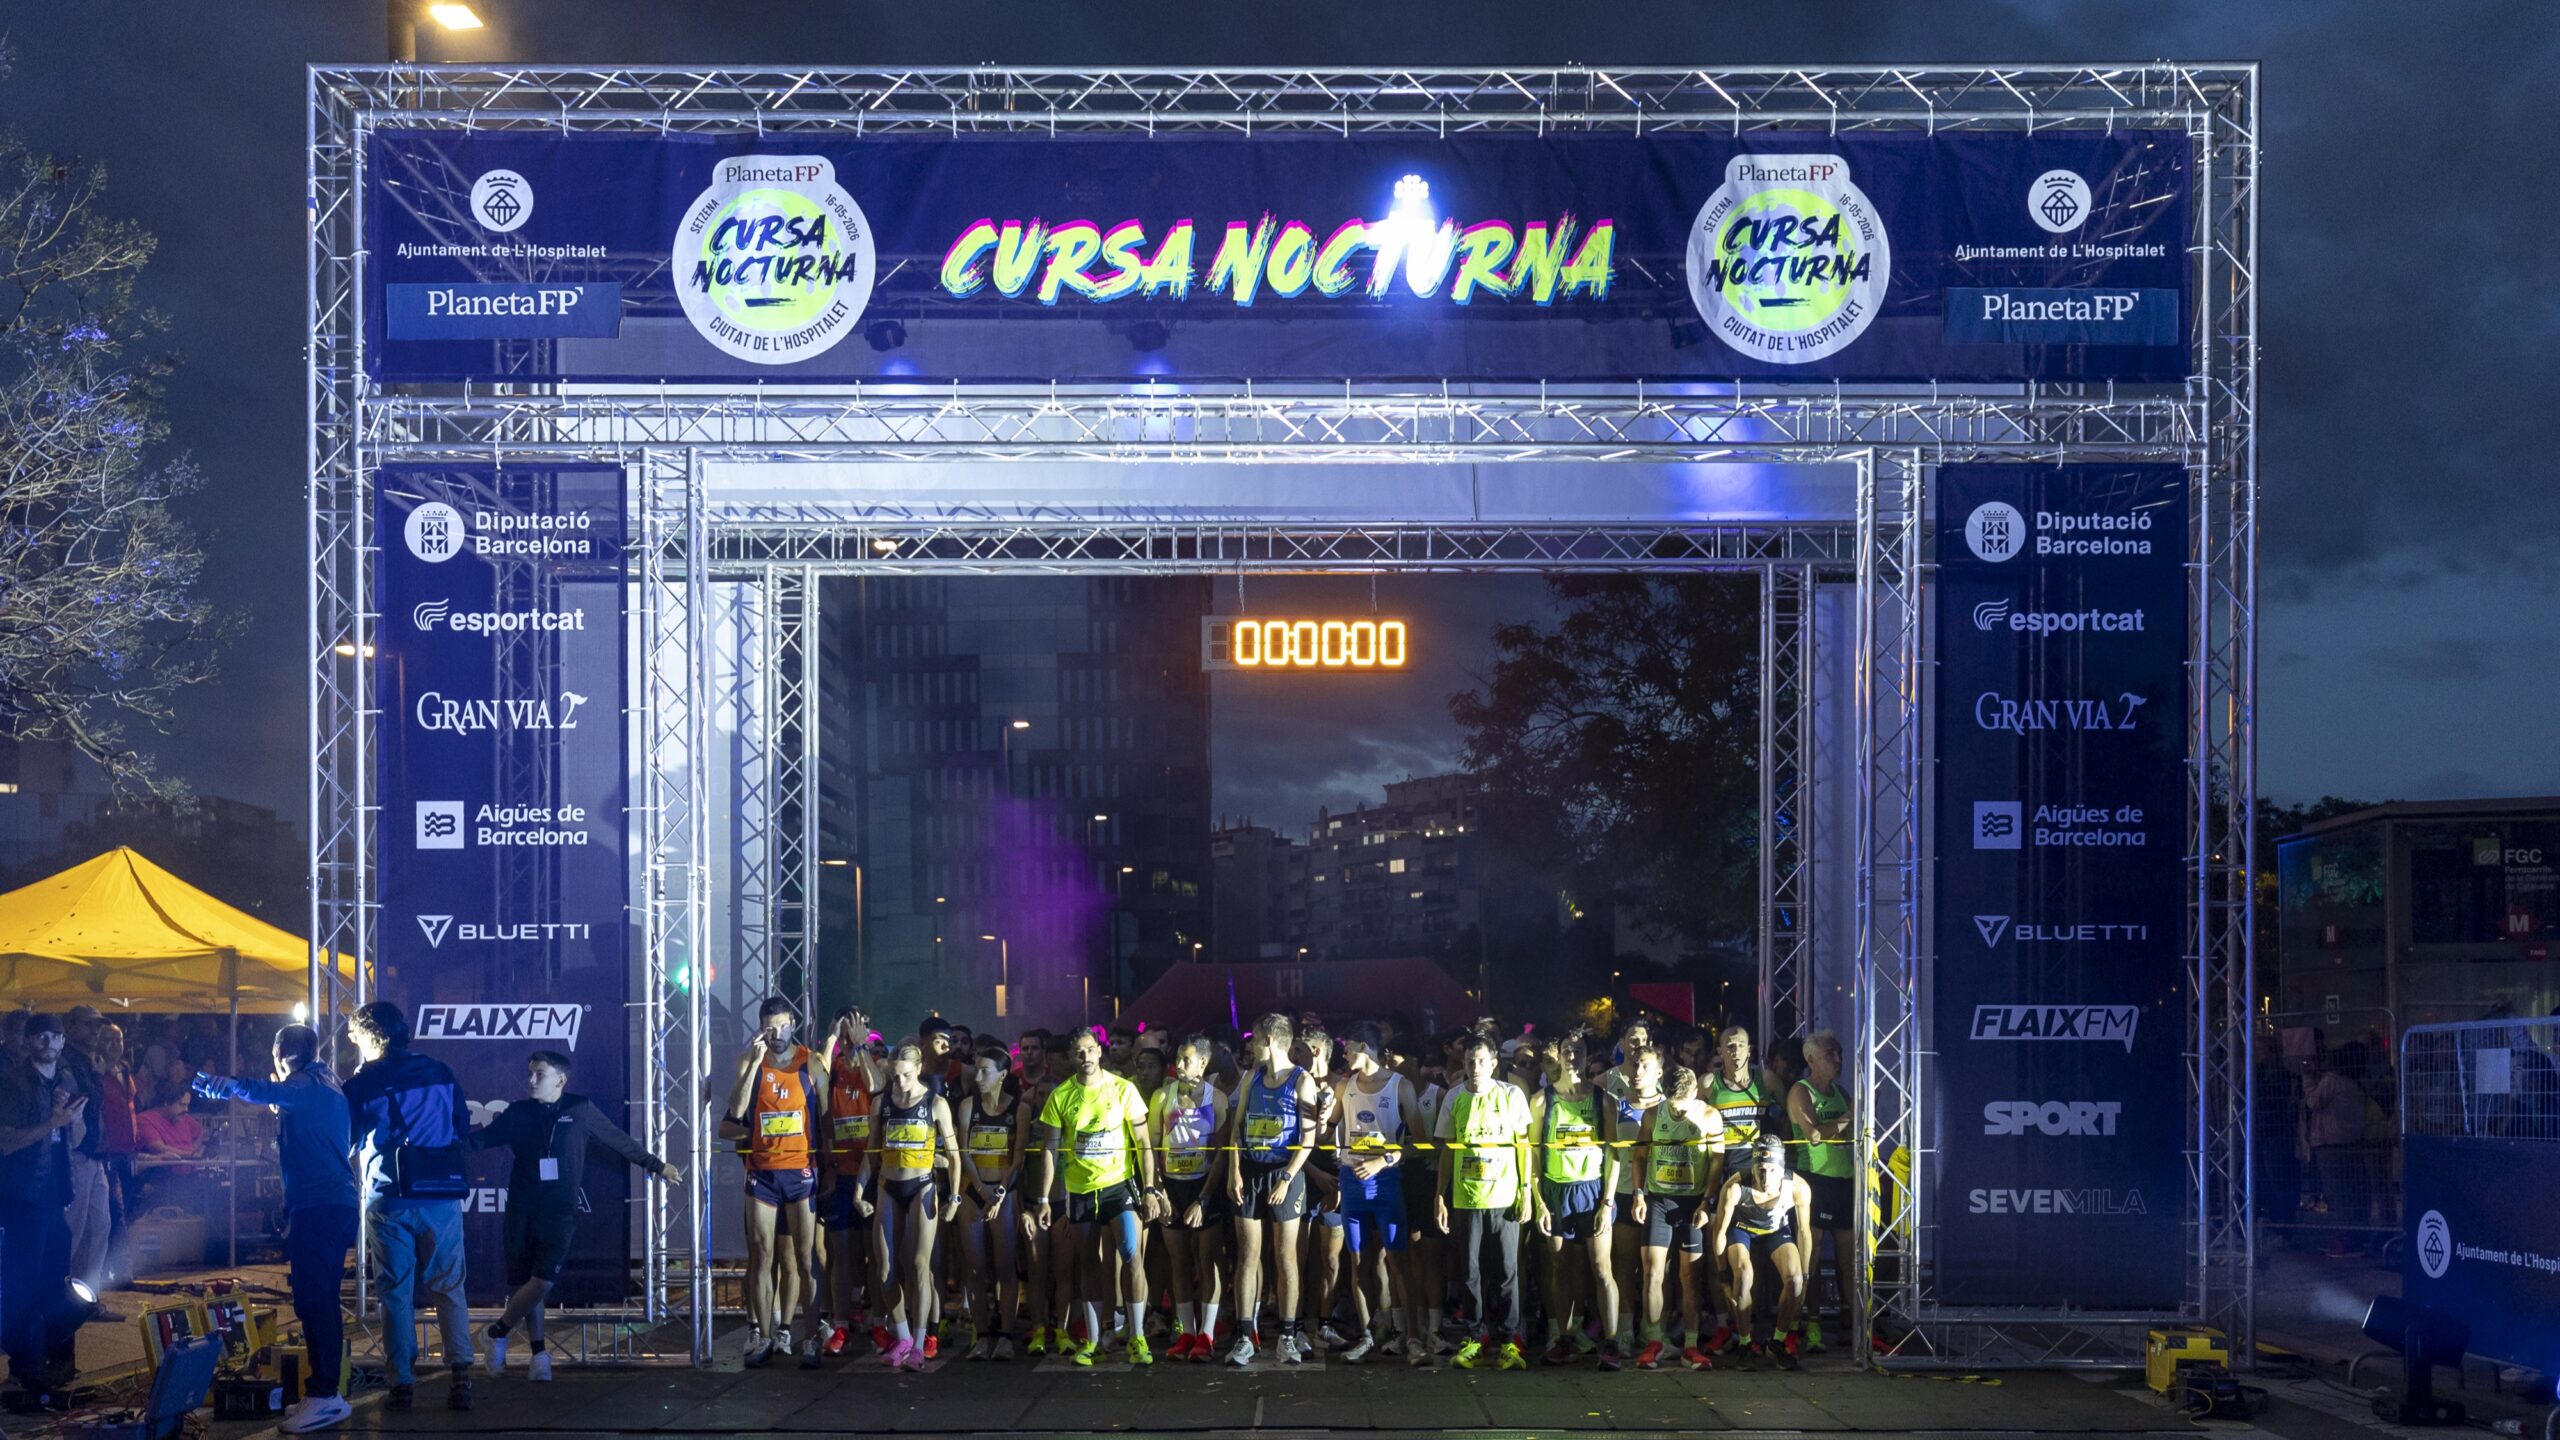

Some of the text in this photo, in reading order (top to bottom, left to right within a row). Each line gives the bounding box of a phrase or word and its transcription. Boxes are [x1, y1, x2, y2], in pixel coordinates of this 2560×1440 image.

[690, 198, 720, 235] SETZENA
[824, 193, 860, 241] 16-05-2026
[1703, 196, 1733, 234] SETZENA
[1839, 192, 1875, 241] 16-05-2026
[709, 213, 829, 252] CURSA
[1720, 213, 1842, 252] CURSA
[397, 242, 607, 260] Ajuntament de L'Hospitalet
[940, 209, 1617, 307] CURSA NOCTURNA
[1954, 243, 2166, 260] Ajuntament de L'Hospitalet
[690, 253, 857, 294] NOCTURNA
[1703, 252, 1872, 292] NOCTURNA
[709, 300, 850, 352] CIUTAT DE L'HOSPITALET
[1723, 300, 1864, 352] CIUTAT DE L'HOSPITALET
[475, 511, 591, 534] Diputació
[2036, 512, 2152, 534] Diputació
[475, 536, 591, 554] Barcelona
[2036, 536, 2152, 555] Barcelona
[450, 608, 585, 637] esportcat
[2009, 608, 2145, 637] esportcat
[1235, 620, 1406, 666] 00:00:00
[417, 691, 588, 736] GRAN VIA 2
[1975, 692, 2148, 736] GRAN VIA 2
[475, 804, 585, 828] Aigües de
[2033, 804, 2143, 828] Aigües de
[477, 827, 588, 846] Barcelona
[2035, 827, 2146, 847] Barcelona
[2504, 849, 2543, 864] FGC
[458, 924, 590, 940] BLUETTI
[2015, 924, 2147, 941] BLUETTI
[2326, 925, 2336, 942] M
[2508, 914, 2529, 933] M
[1984, 1101, 2122, 1136] SPORT
[1969, 1189, 2148, 1215] SEVENMILA
[2455, 1242, 2509, 1264] Ajuntament
[2510, 1251, 2523, 1266] de
